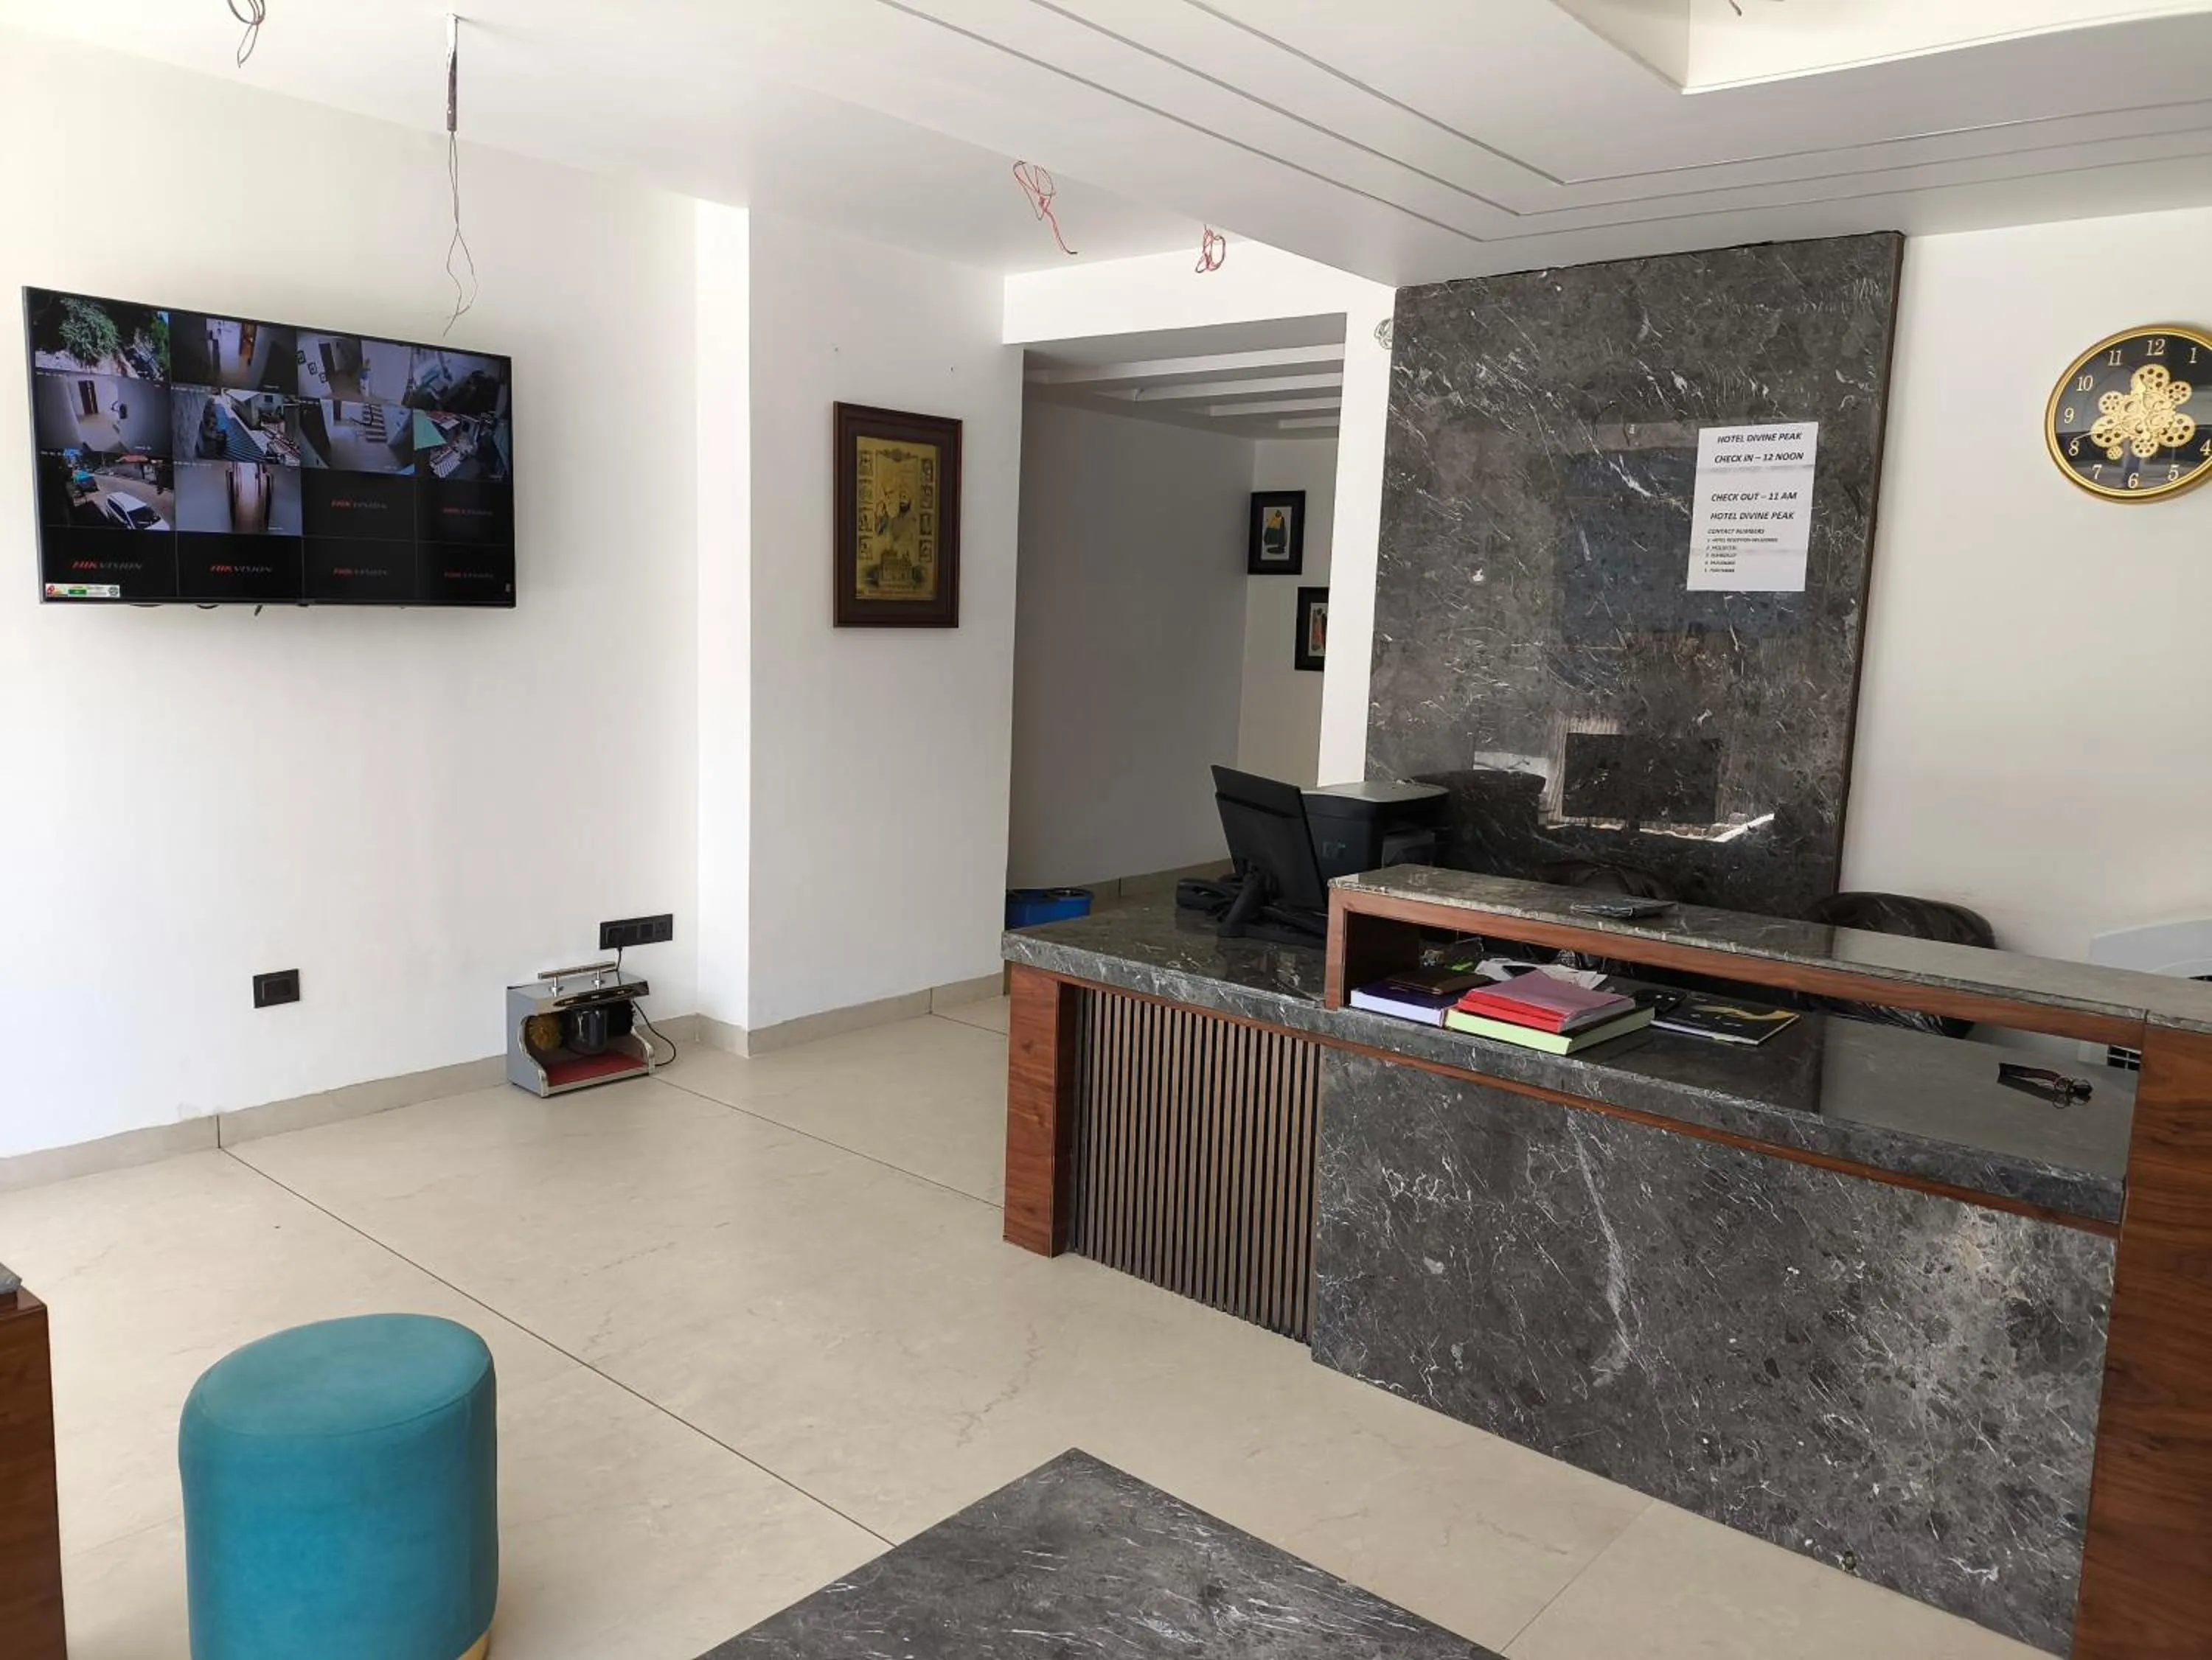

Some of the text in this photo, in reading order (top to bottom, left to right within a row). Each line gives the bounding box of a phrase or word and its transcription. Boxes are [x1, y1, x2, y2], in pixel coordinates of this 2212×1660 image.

[2146, 339, 2166, 356] 12
[2188, 347, 2197, 363] 1
[2108, 350, 2122, 366] 11
[2076, 374, 2093, 391] 10
[2064, 407, 2074, 425] 9
[1717, 431, 1802, 444] HOTEL DIVINE PEAK
[2068, 439, 2079, 456] 8
[2199, 439, 2212, 456] 4
[1714, 455, 1742, 464] CHECK
[1743, 453, 1754, 462] IN
[1762, 453, 1773, 461] 12
[1775, 452, 1804, 461] NOON
[2092, 464, 2103, 480] 7
[2168, 464, 2180, 481] 5
[2127, 472, 2139, 489] 6
[1711, 493, 1739, 502] CHECK
[1740, 492, 1759, 501] OUT
[1768, 492, 1779, 501] 11
[1780, 492, 1798, 500] AM
[1770, 511, 1794, 520] PEAK
